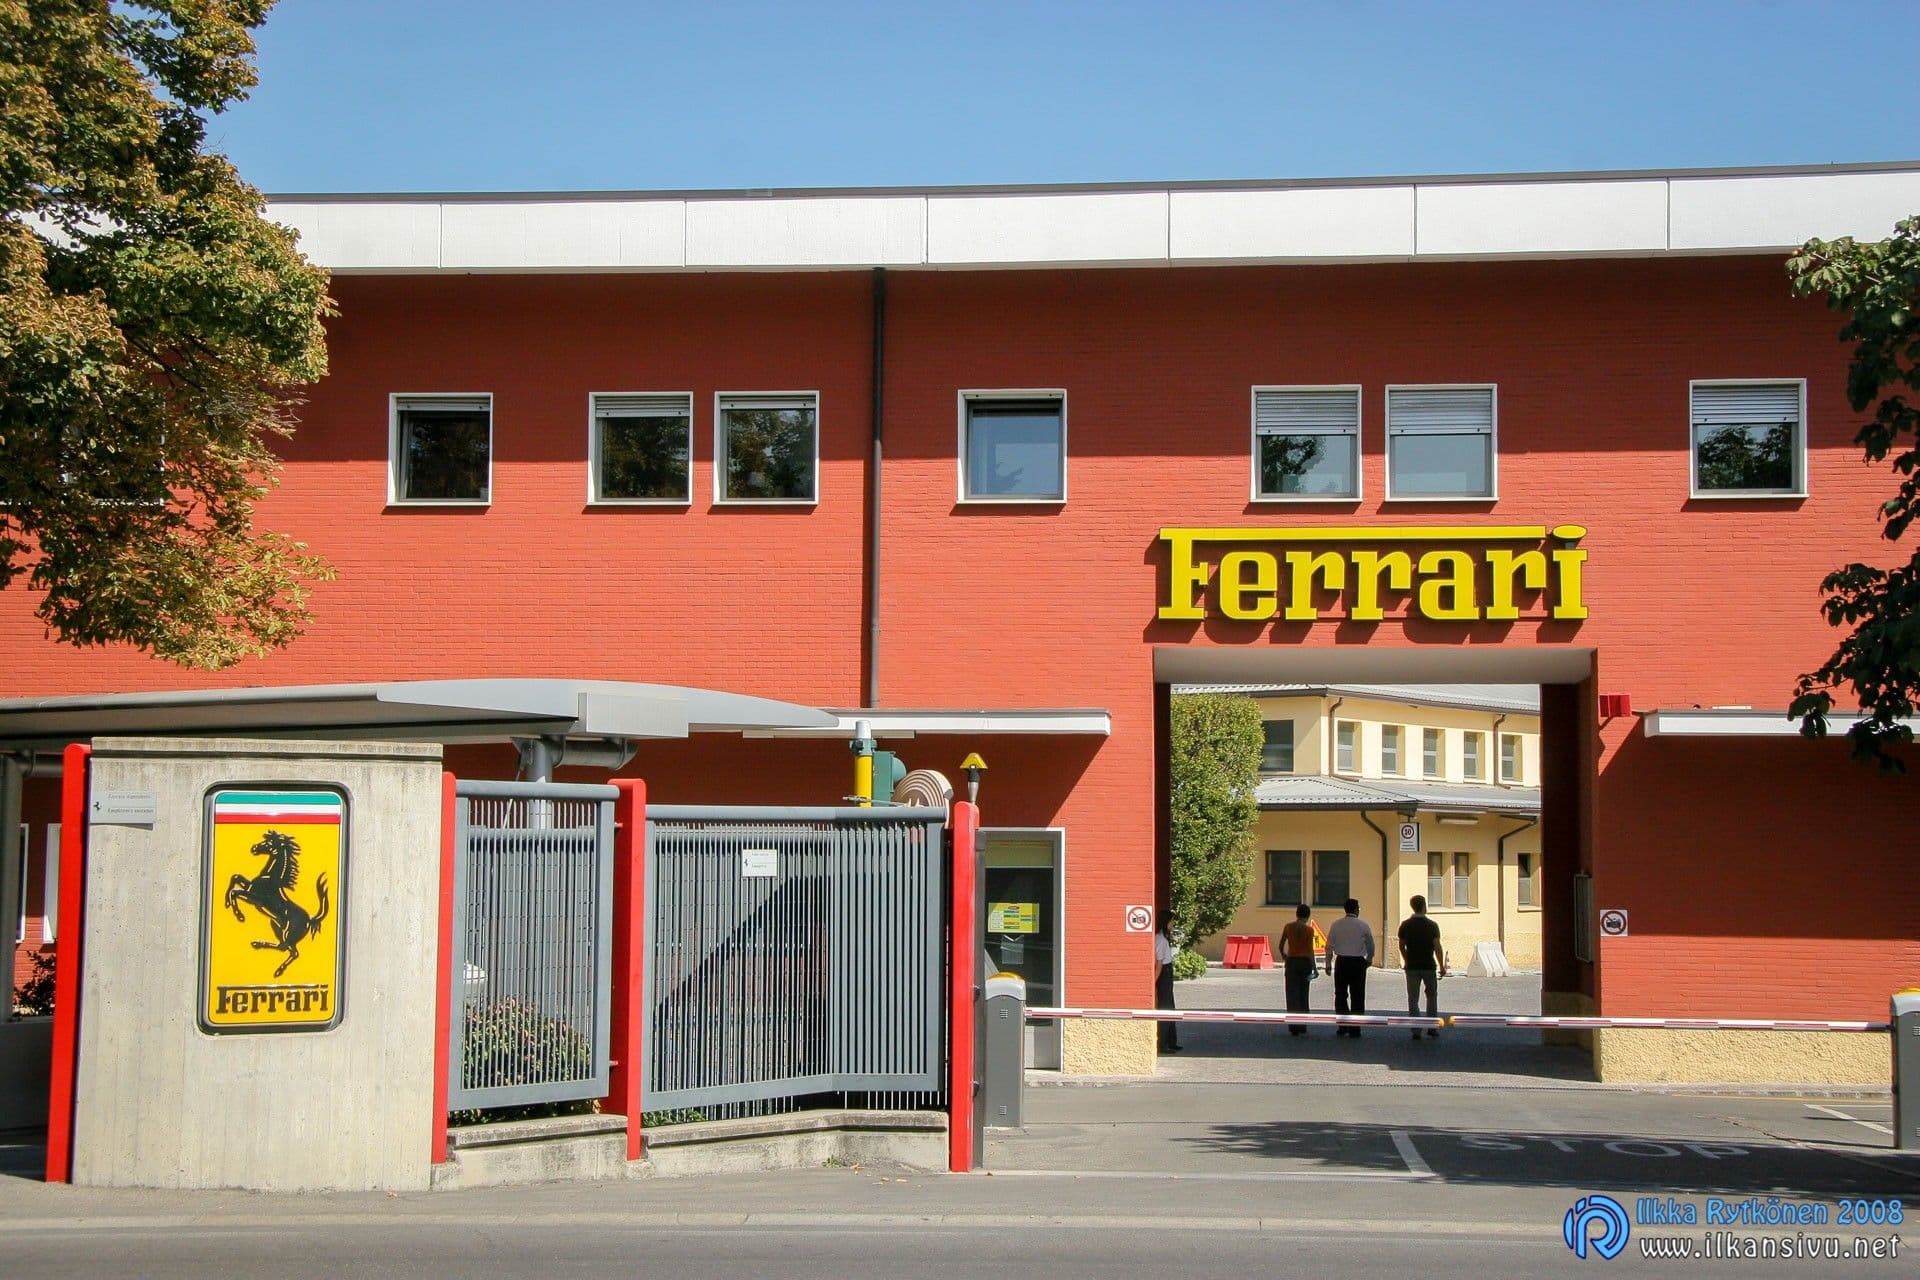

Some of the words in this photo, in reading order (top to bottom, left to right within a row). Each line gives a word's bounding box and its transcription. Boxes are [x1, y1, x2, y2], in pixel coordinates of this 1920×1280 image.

[1158, 525, 1588, 620] Ferrari
[216, 984, 328, 1014] Ferrari
[1460, 1134, 1750, 1159] STOP
